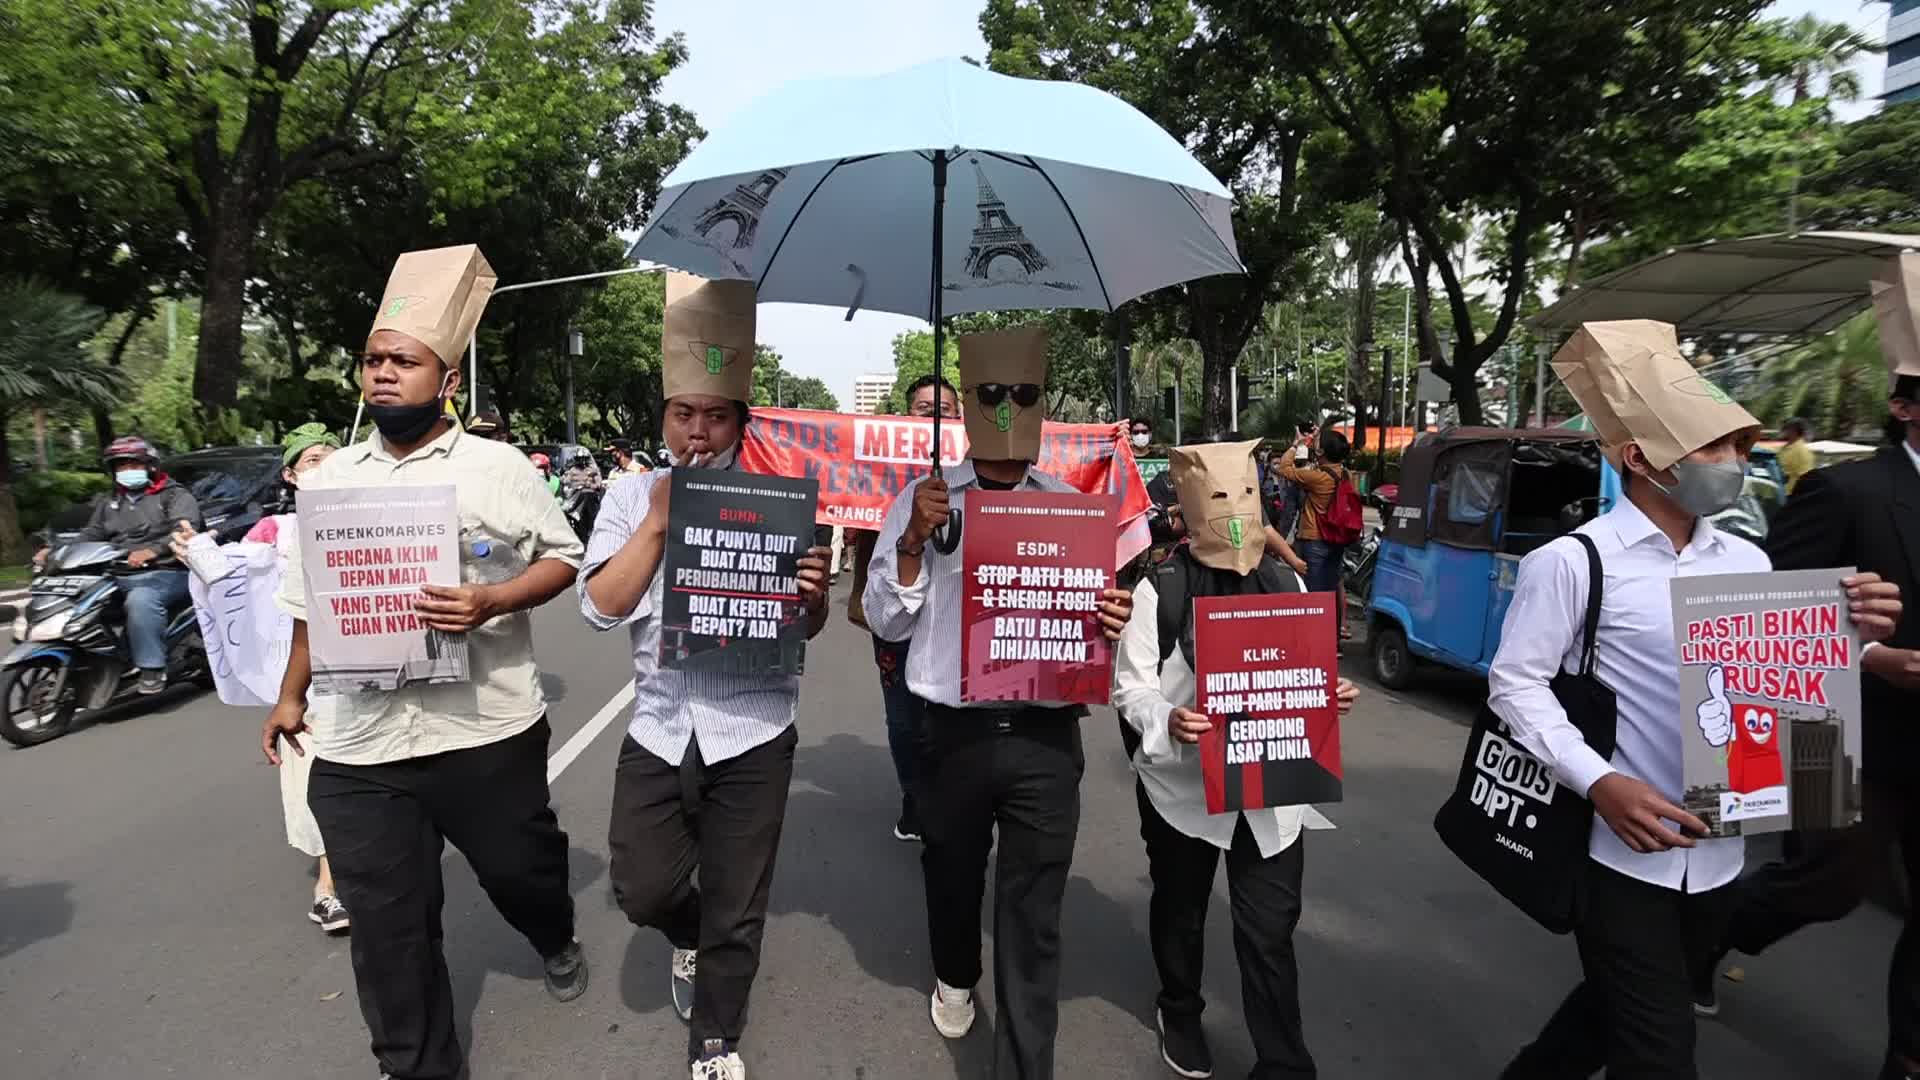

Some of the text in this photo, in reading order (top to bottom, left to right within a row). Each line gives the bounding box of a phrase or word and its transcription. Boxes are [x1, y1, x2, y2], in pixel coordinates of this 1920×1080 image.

[719, 508, 764, 523] BUMN:
[315, 524, 446, 542] KEMENKOMARVES
[684, 526, 797, 554] GAK PUNYA DUIT
[326, 545, 438, 568] BENCANA IKLIM
[701, 549, 777, 573] BUAT ATASI
[1017, 541, 1067, 557] ESDM:
[340, 566, 427, 588] DEPAN MATA
[676, 568, 798, 594] PERUBAHAN IKLIM
[978, 565, 1104, 589] STOP BATU BARA
[330, 593, 434, 616] YANG PENT
[688, 595, 783, 620] BUAT KERETA
[982, 589, 1099, 611] & ENERGI FOSIL
[341, 618, 382, 637] CUAN
[691, 616, 777, 639] CEPAT? ADA
[994, 617, 1083, 640] BATU BARA
[1687, 603, 1839, 643] PASTI BIKIN
[989, 638, 1086, 662] DIHIJAUKAN
[1243, 648, 1286, 662] KLHK:
[1681, 637, 1849, 668] LINGKUNGAN
[1205, 667, 1328, 693] HUTAN INDONESIA:
[1725, 665, 1828, 707] RUSAK
[1285, 689, 1328, 710] DUNIA
[1230, 717, 1305, 742] CEROBONG
[1226, 738, 1311, 765] ASAP DUNIA
[1495, 833, 1534, 861] JAKARTA
